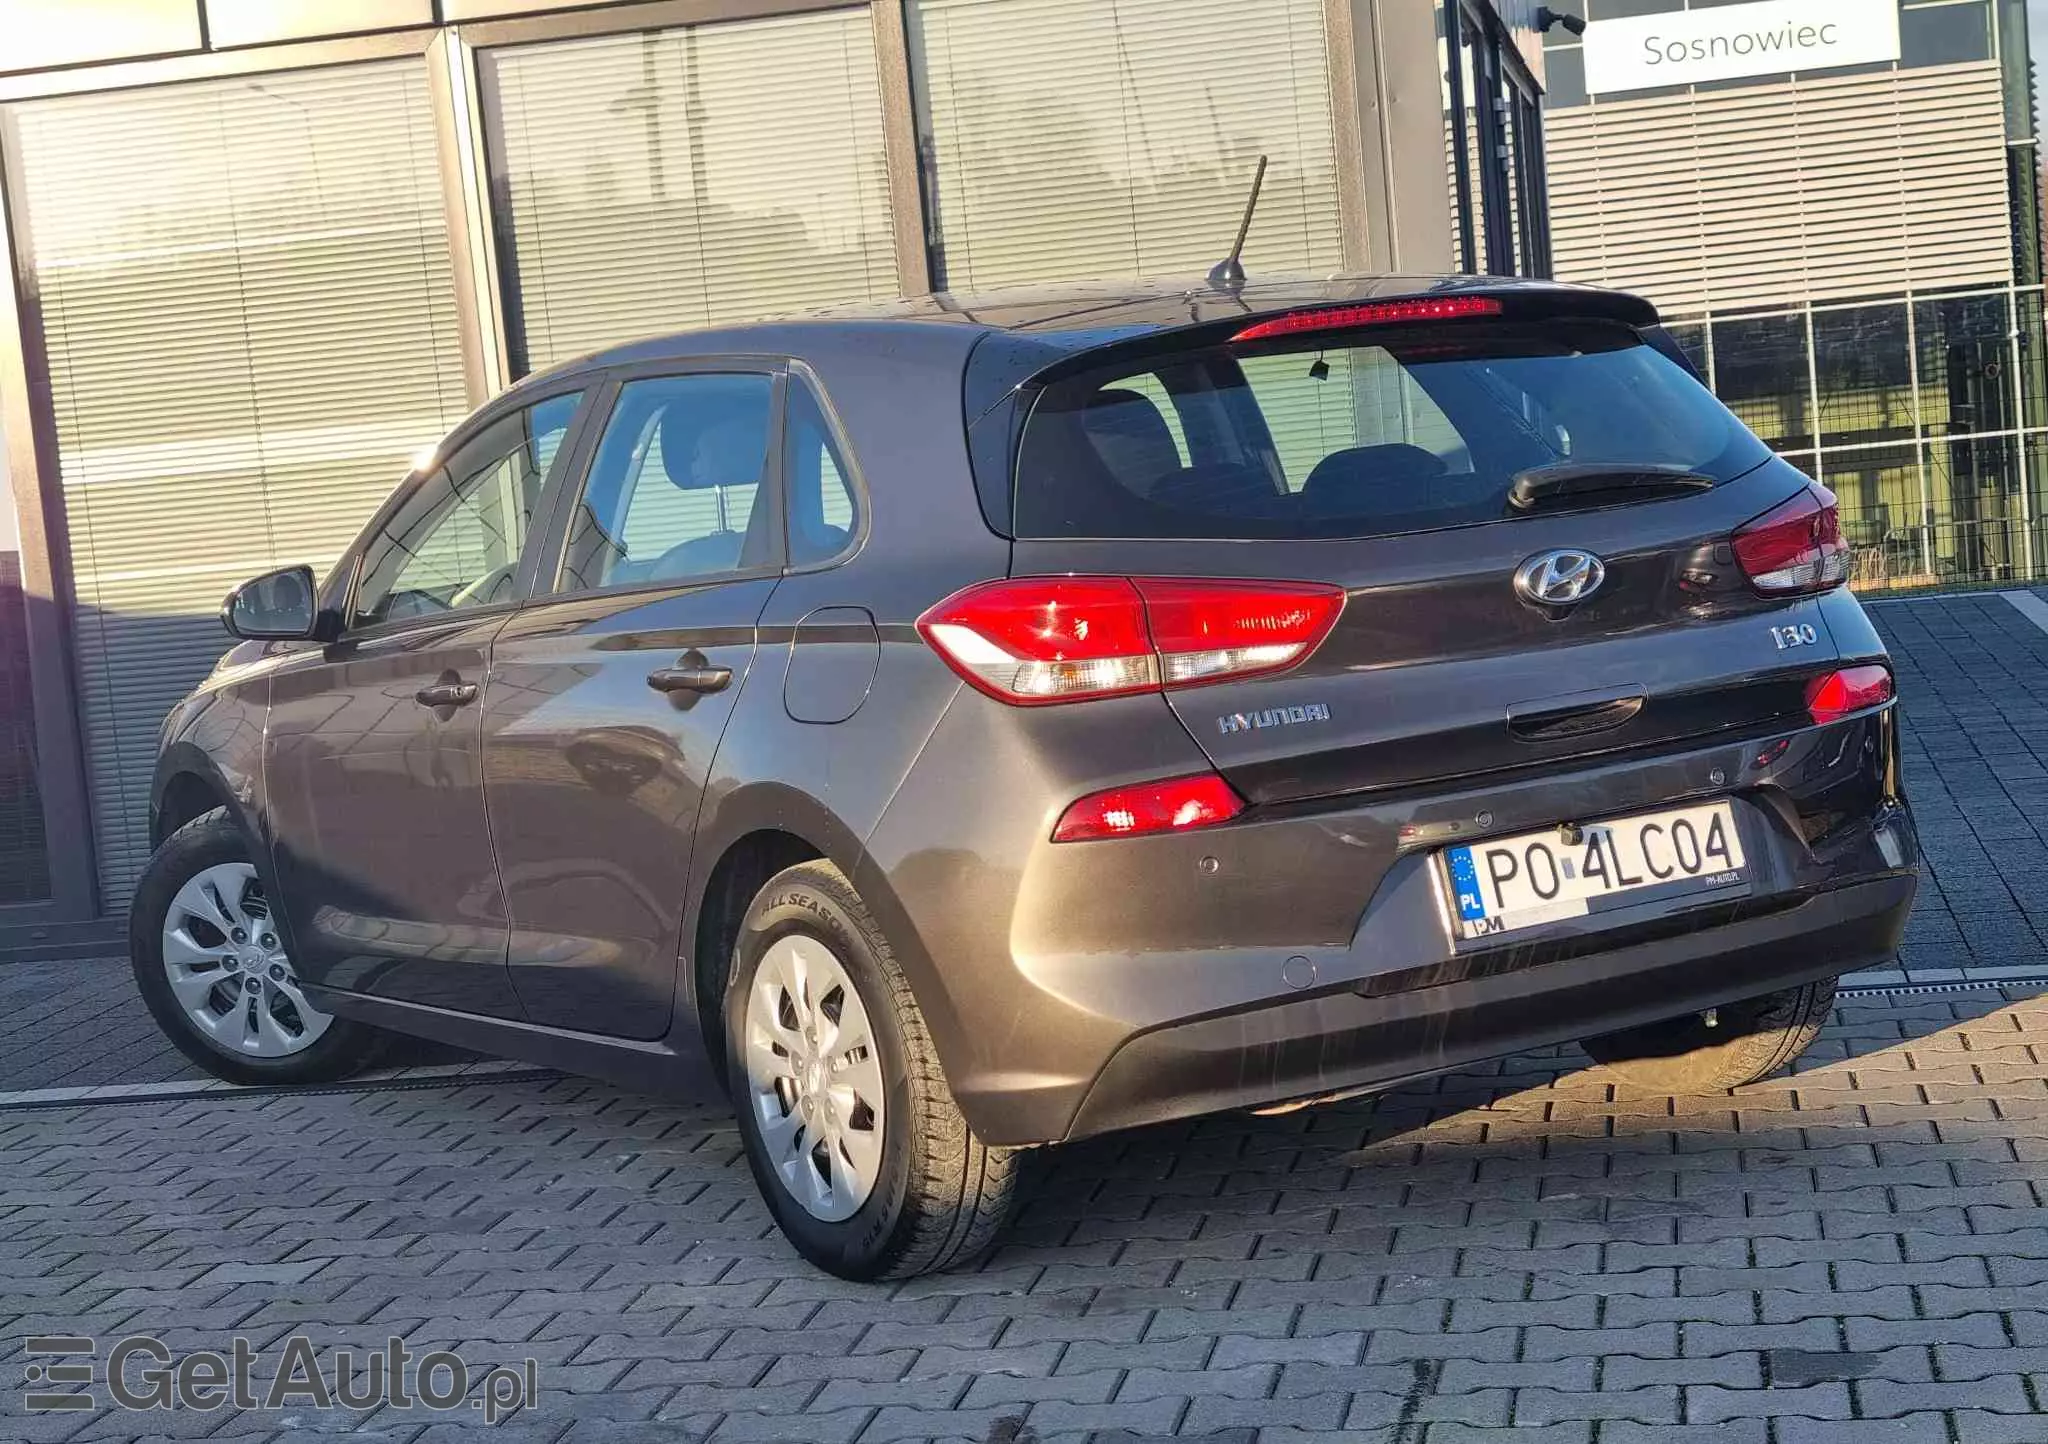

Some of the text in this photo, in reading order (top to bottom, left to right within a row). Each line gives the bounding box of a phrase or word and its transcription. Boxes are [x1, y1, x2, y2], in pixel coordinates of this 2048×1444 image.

[1644, 20, 1838, 65] Sosnowiec
[1219, 703, 1330, 734] HYUNDAI
[1486, 812, 1733, 908] PO 4LC04
[761, 895, 786, 917] ALL
[1460, 893, 1481, 911] PL
